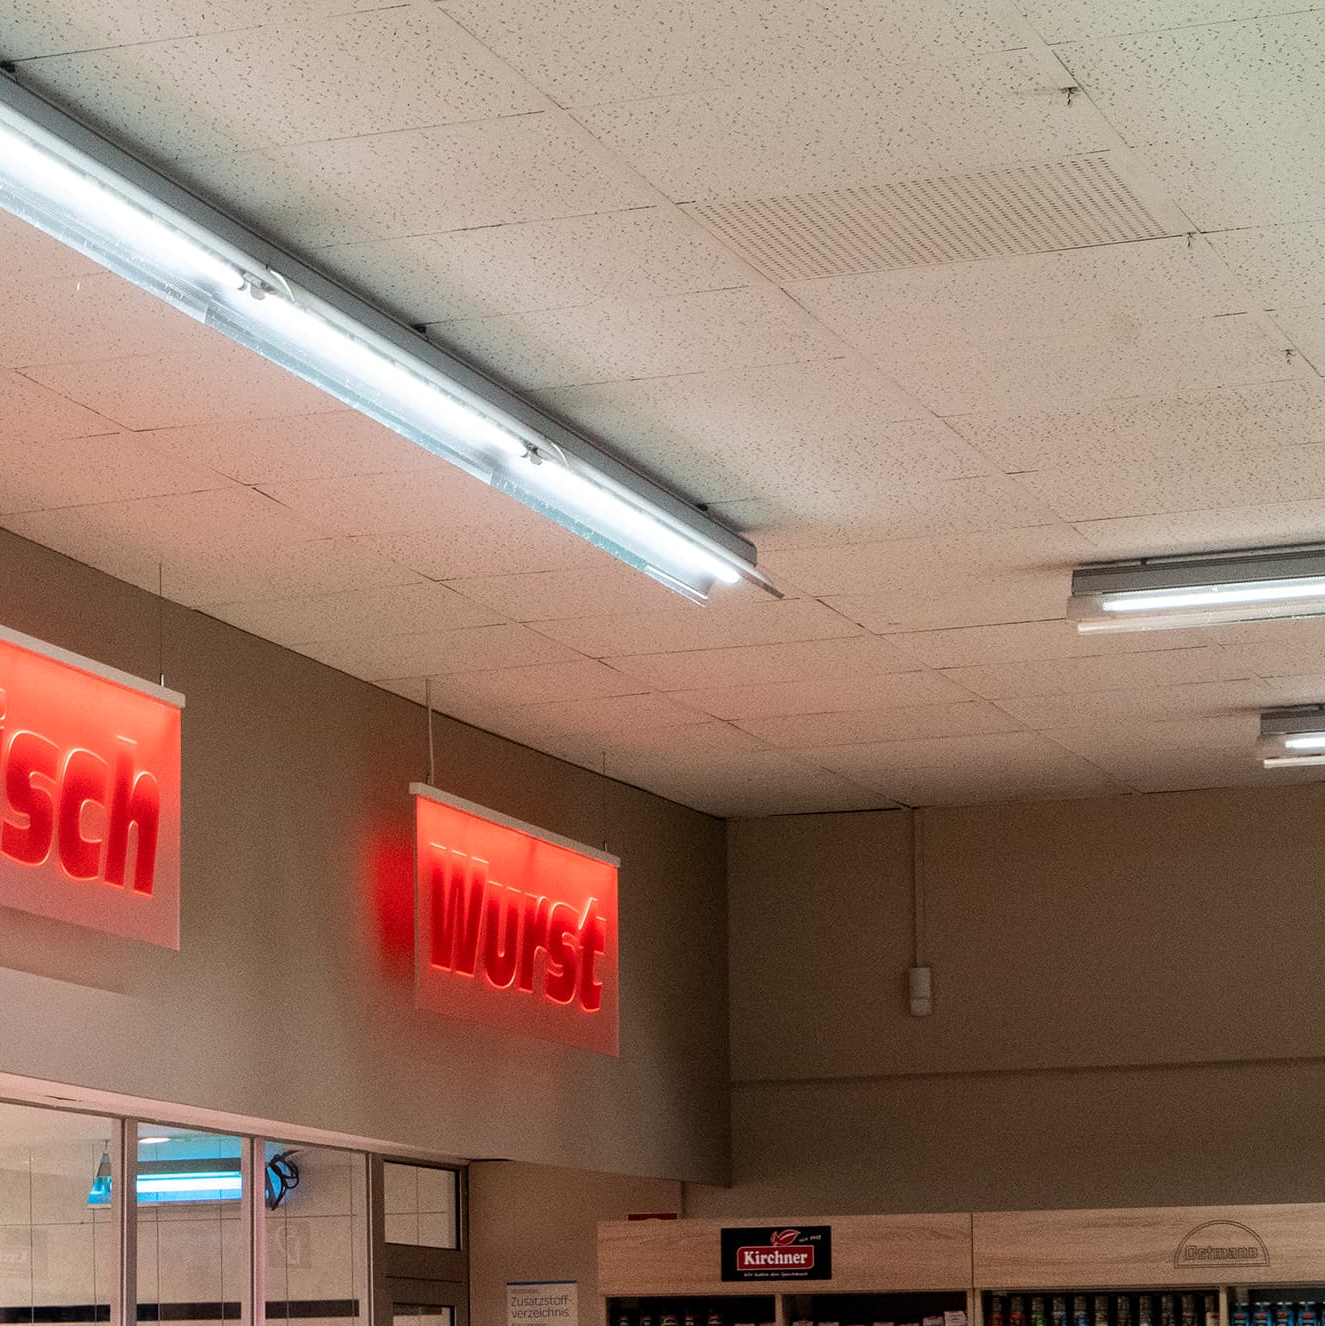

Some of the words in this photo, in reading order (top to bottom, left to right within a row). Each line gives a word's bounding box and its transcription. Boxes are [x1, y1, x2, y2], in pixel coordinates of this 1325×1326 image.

[430, 842, 606, 1013] Wurst
[743, 1250, 809, 1266] Kirchner
[1185, 1244, 1259, 1261] Ostmann
[510, 1294, 573, 1307] Zusatzstoff-
[510, 1308, 570, 1319] verzeichnis
